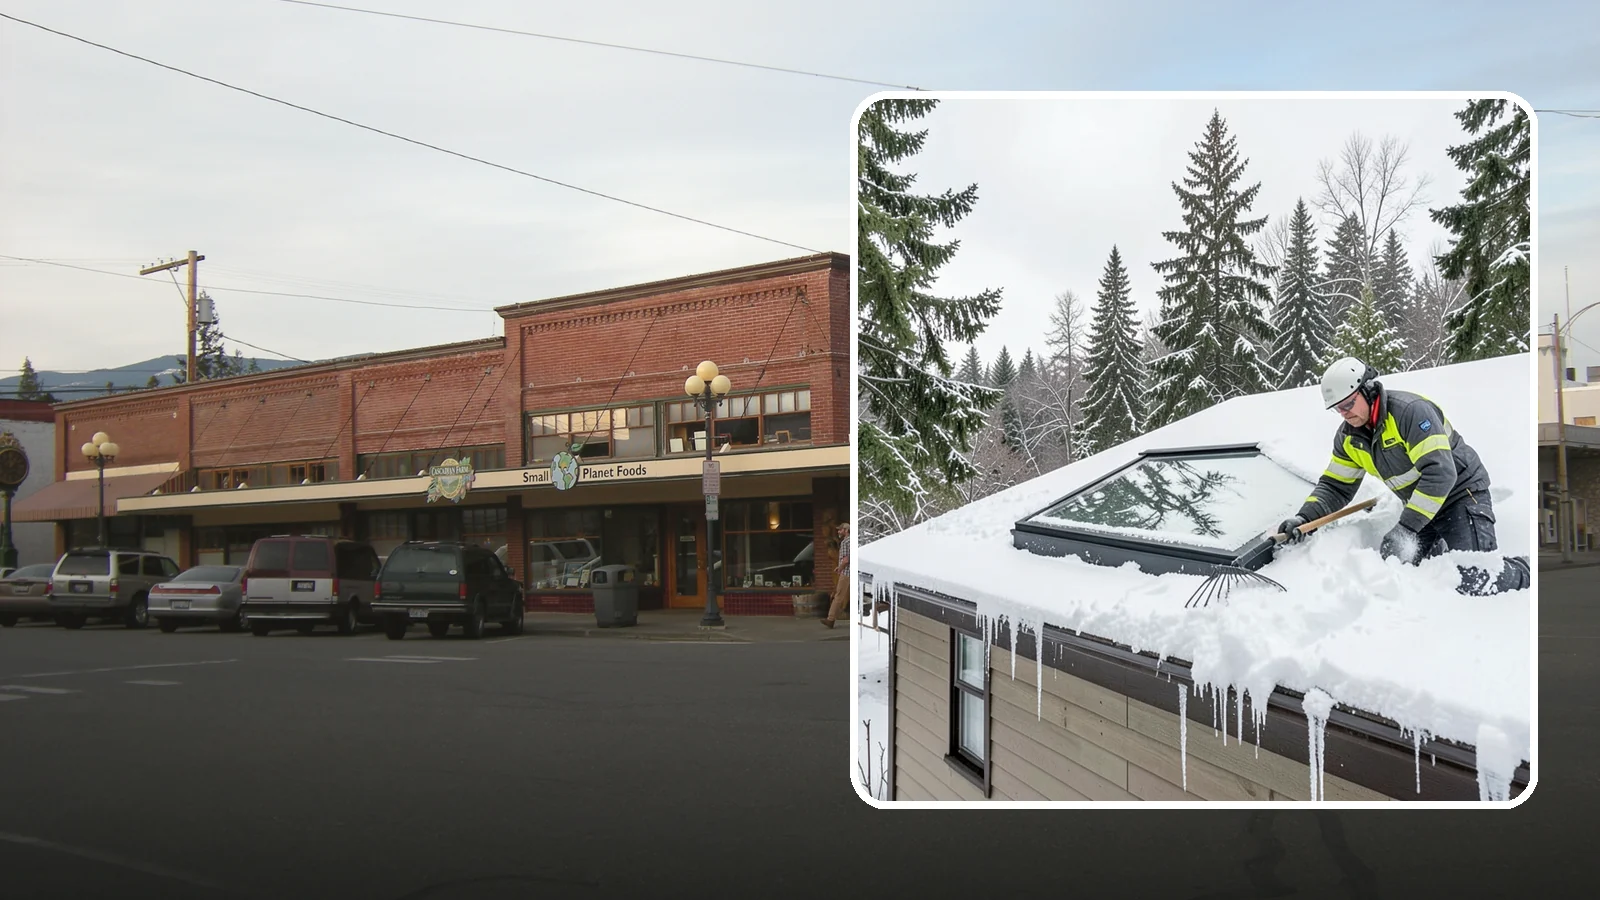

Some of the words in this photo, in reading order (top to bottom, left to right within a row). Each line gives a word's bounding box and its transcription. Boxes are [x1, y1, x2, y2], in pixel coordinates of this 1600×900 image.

[523, 471, 549, 483] Small
[582, 468, 614, 479] Planet
[617, 464, 647, 477] Foods
